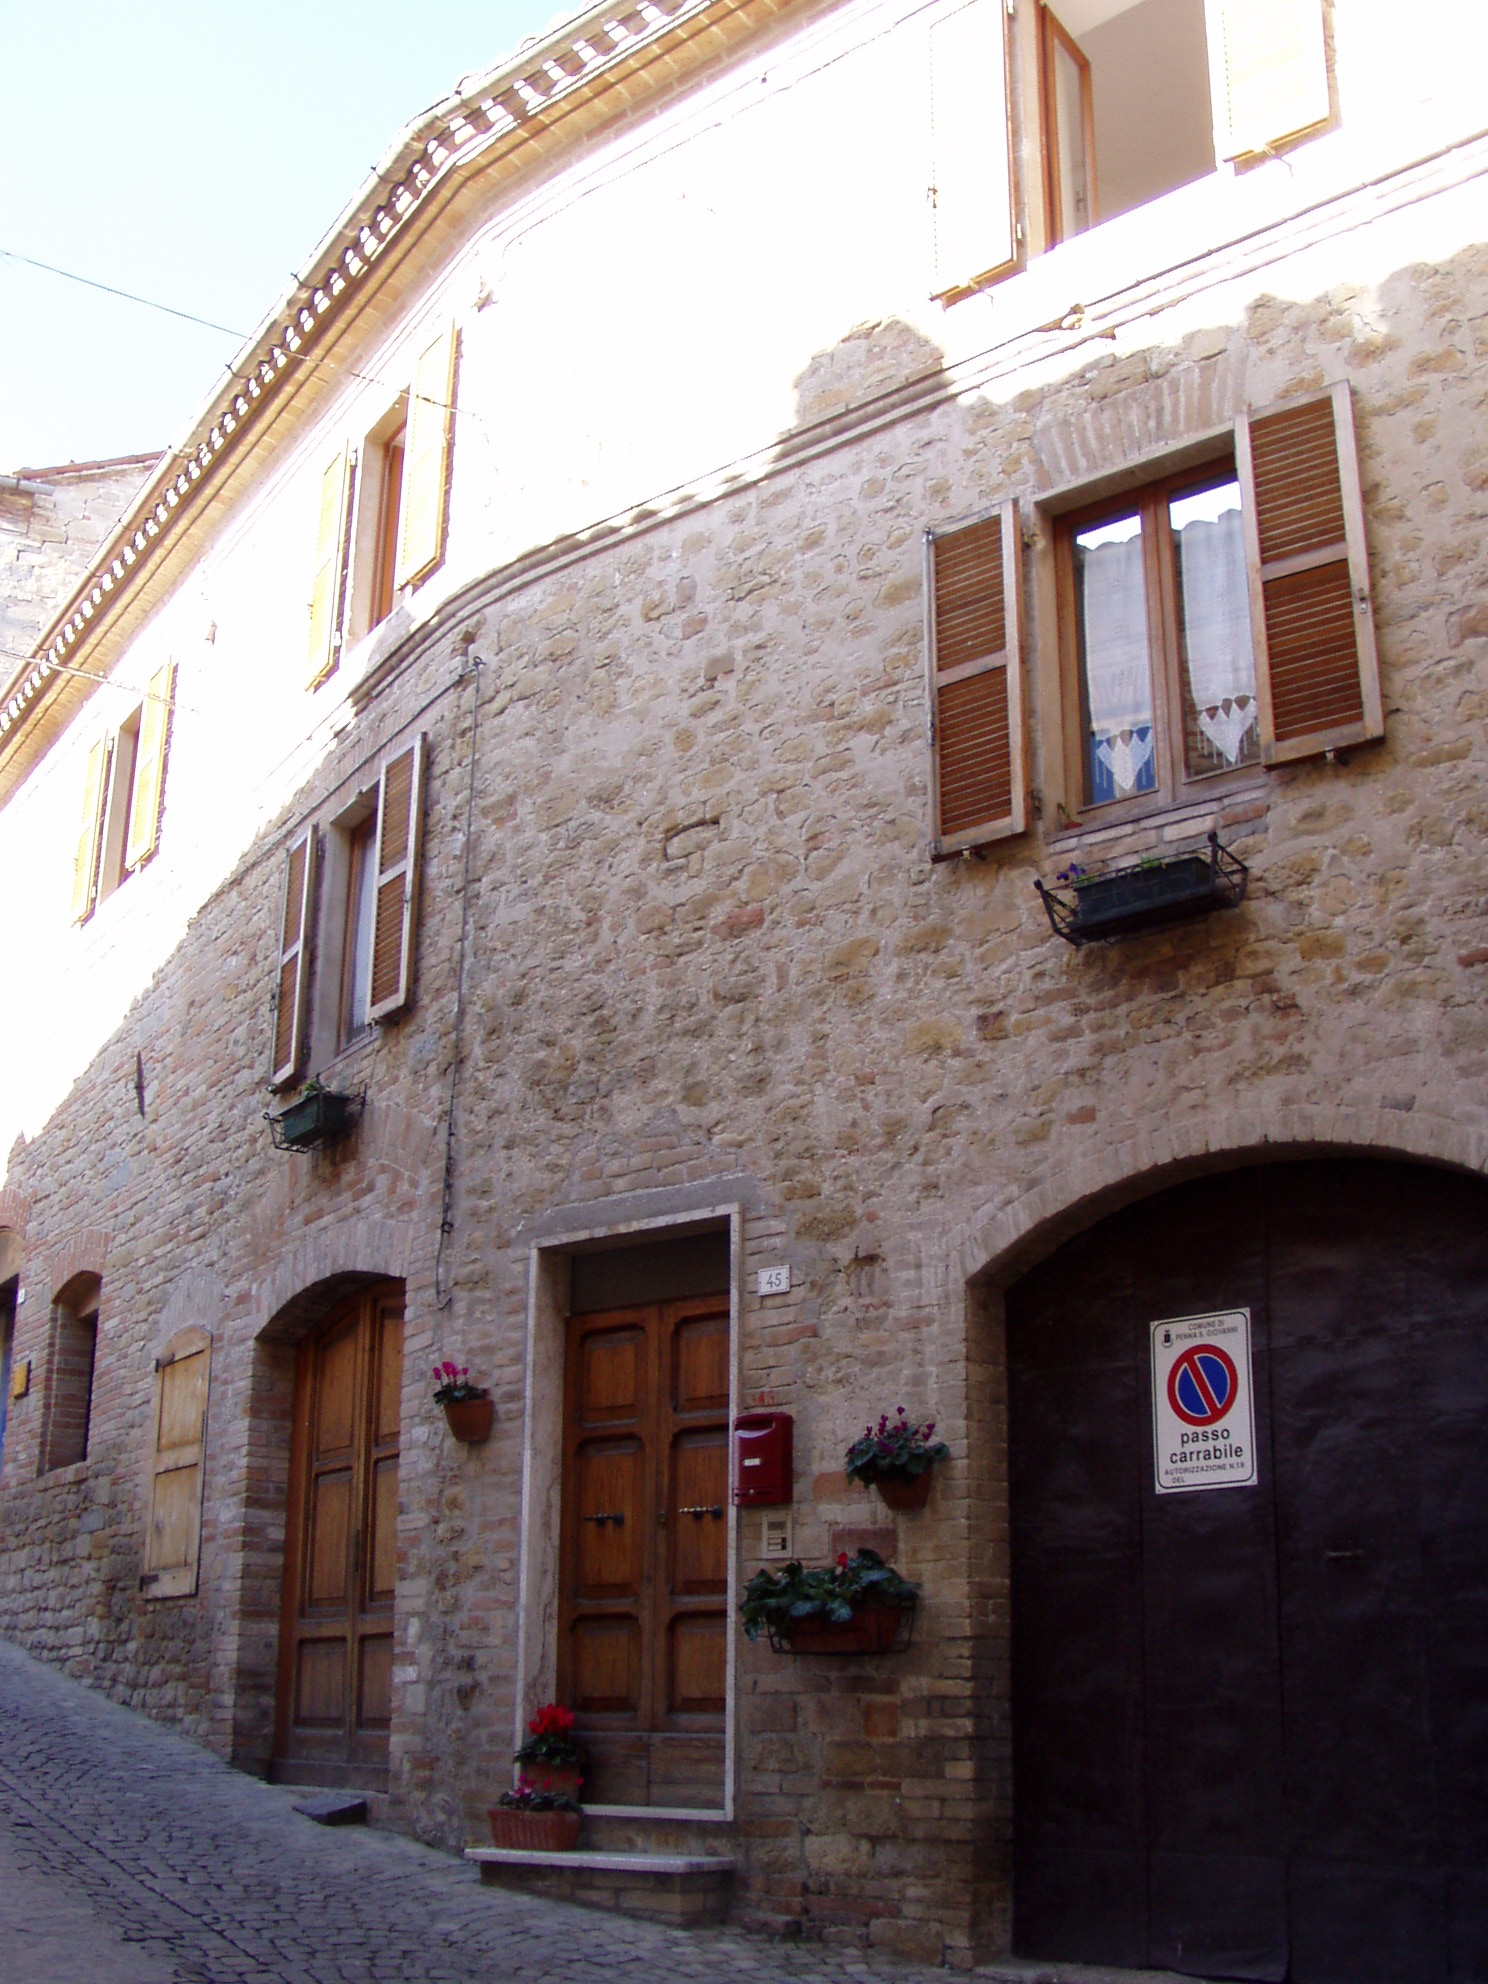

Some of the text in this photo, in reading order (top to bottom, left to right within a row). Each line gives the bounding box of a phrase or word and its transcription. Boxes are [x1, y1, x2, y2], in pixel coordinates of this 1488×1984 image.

[766, 1273, 782, 1288] 45
[1188, 1319, 1225, 1331] COMUNE DI
[1175, 1331, 1198, 1341] PENNA
[1206, 1326, 1239, 1337] GIOVANNI
[1181, 1428, 1231, 1448] passo
[1170, 1443, 1243, 1464] carrabile
[1164, 1463, 1227, 1476] AUTORIZZAZIONE
[1171, 1475, 1185, 1484] DEL
